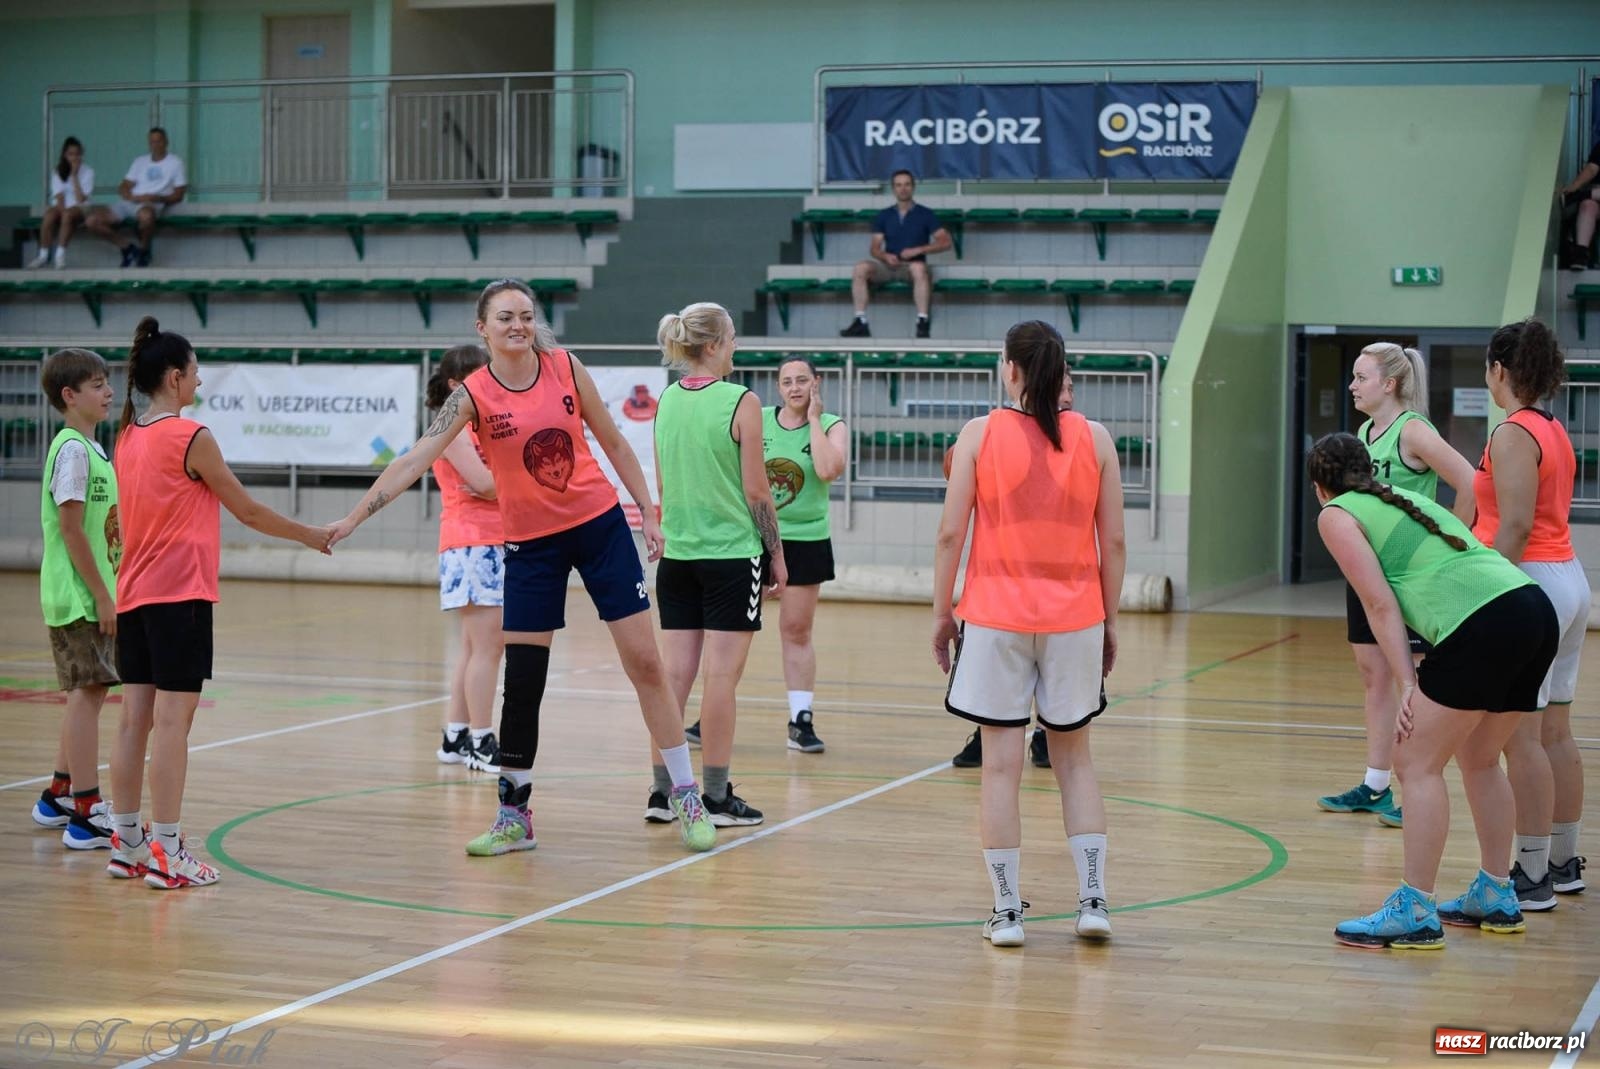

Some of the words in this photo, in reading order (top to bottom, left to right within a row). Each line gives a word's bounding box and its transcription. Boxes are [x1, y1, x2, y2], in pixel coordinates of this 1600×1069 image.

[865, 109, 1042, 146] RACIBÓRZ
[1098, 102, 1213, 142] OSiR
[1143, 143, 1213, 157] RACIBÓRZ
[208, 395, 245, 411] CUK
[257, 396, 398, 414] UBEZPIECZENIA
[562, 395, 575, 415] 8
[484, 412, 514, 424] LETNIA
[492, 421, 512, 431] LIGA
[241, 424, 255, 436] W
[258, 424, 332, 437] RACIBORZU
[490, 427, 519, 440] KOBIET
[1083, 847, 1100, 889] SPALDING
